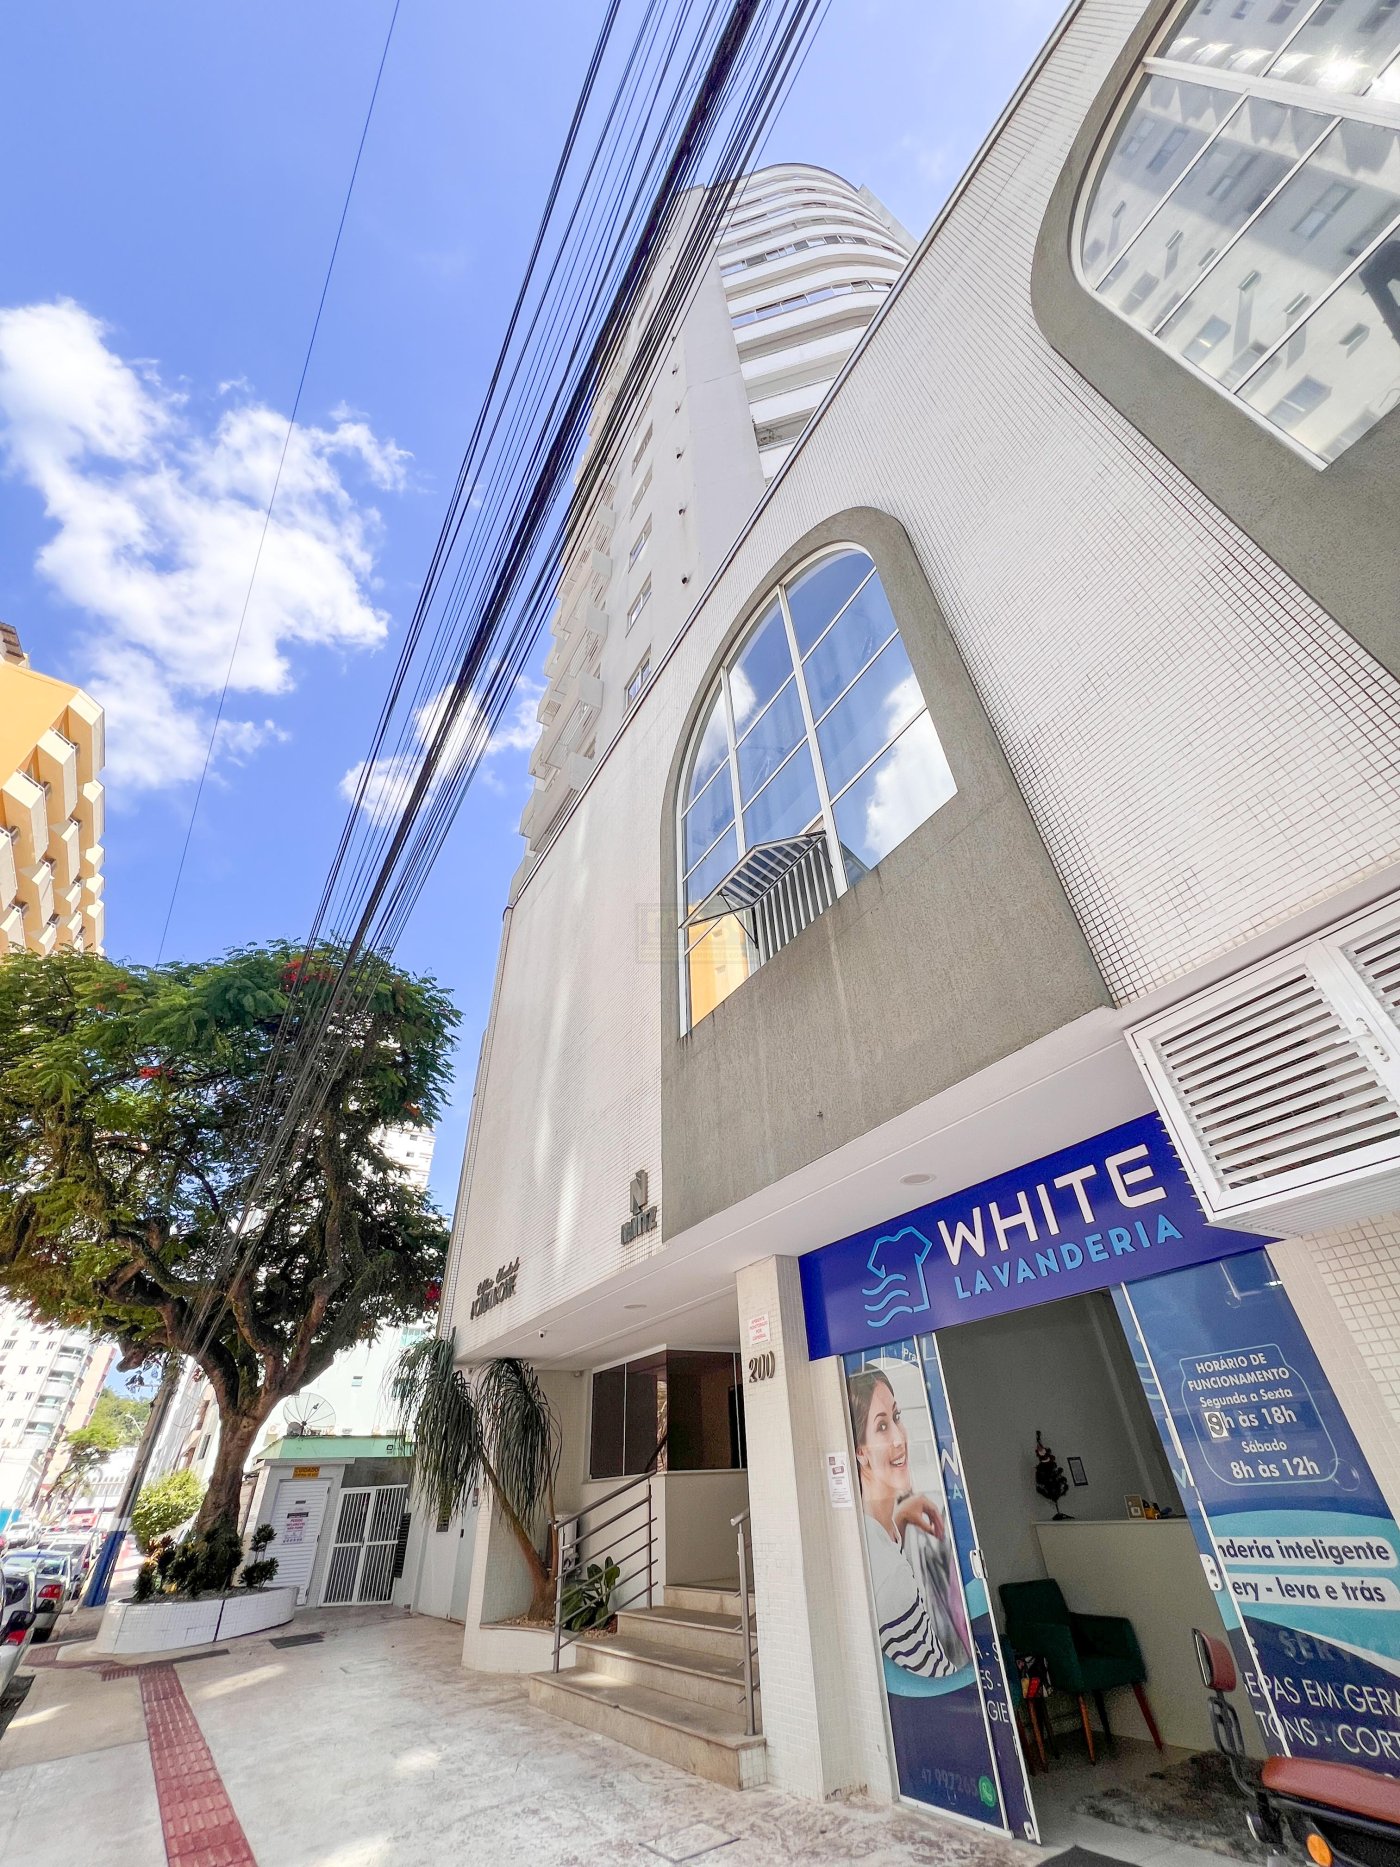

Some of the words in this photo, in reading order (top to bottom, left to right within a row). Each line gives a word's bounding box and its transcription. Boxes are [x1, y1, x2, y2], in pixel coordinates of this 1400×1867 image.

[937, 1144, 1167, 1265] WHITE
[954, 1214, 1183, 1299] LAVANDERIA
[749, 1350, 775, 1383] 200
[1196, 1356, 1248, 1374] HORÁRIO
[1249, 1353, 1267, 1365] DE
[1187, 1367, 1290, 1391] FUNCIONAMENTO
[1200, 1392, 1248, 1409] Segunda
[1250, 1393, 1258, 1402] a
[1260, 1387, 1293, 1400] Sexta
[1207, 1411, 1235, 1437] 9h
[1238, 1410, 1259, 1428] às
[1261, 1405, 1297, 1425] 18h
[1241, 1438, 1288, 1453] Sábado
[1230, 1461, 1255, 1479] 8h
[1258, 1460, 1280, 1477] às
[1282, 1456, 1320, 1476] 12h
[1275, 1538, 1391, 1565] inteligente
[1232, 1580, 1259, 1601] ery
[1275, 1577, 1321, 1599] leva
[1325, 1584, 1338, 1600] e
[1341, 1580, 1387, 1602] trás
[1301, 1679, 1342, 1709] EM
